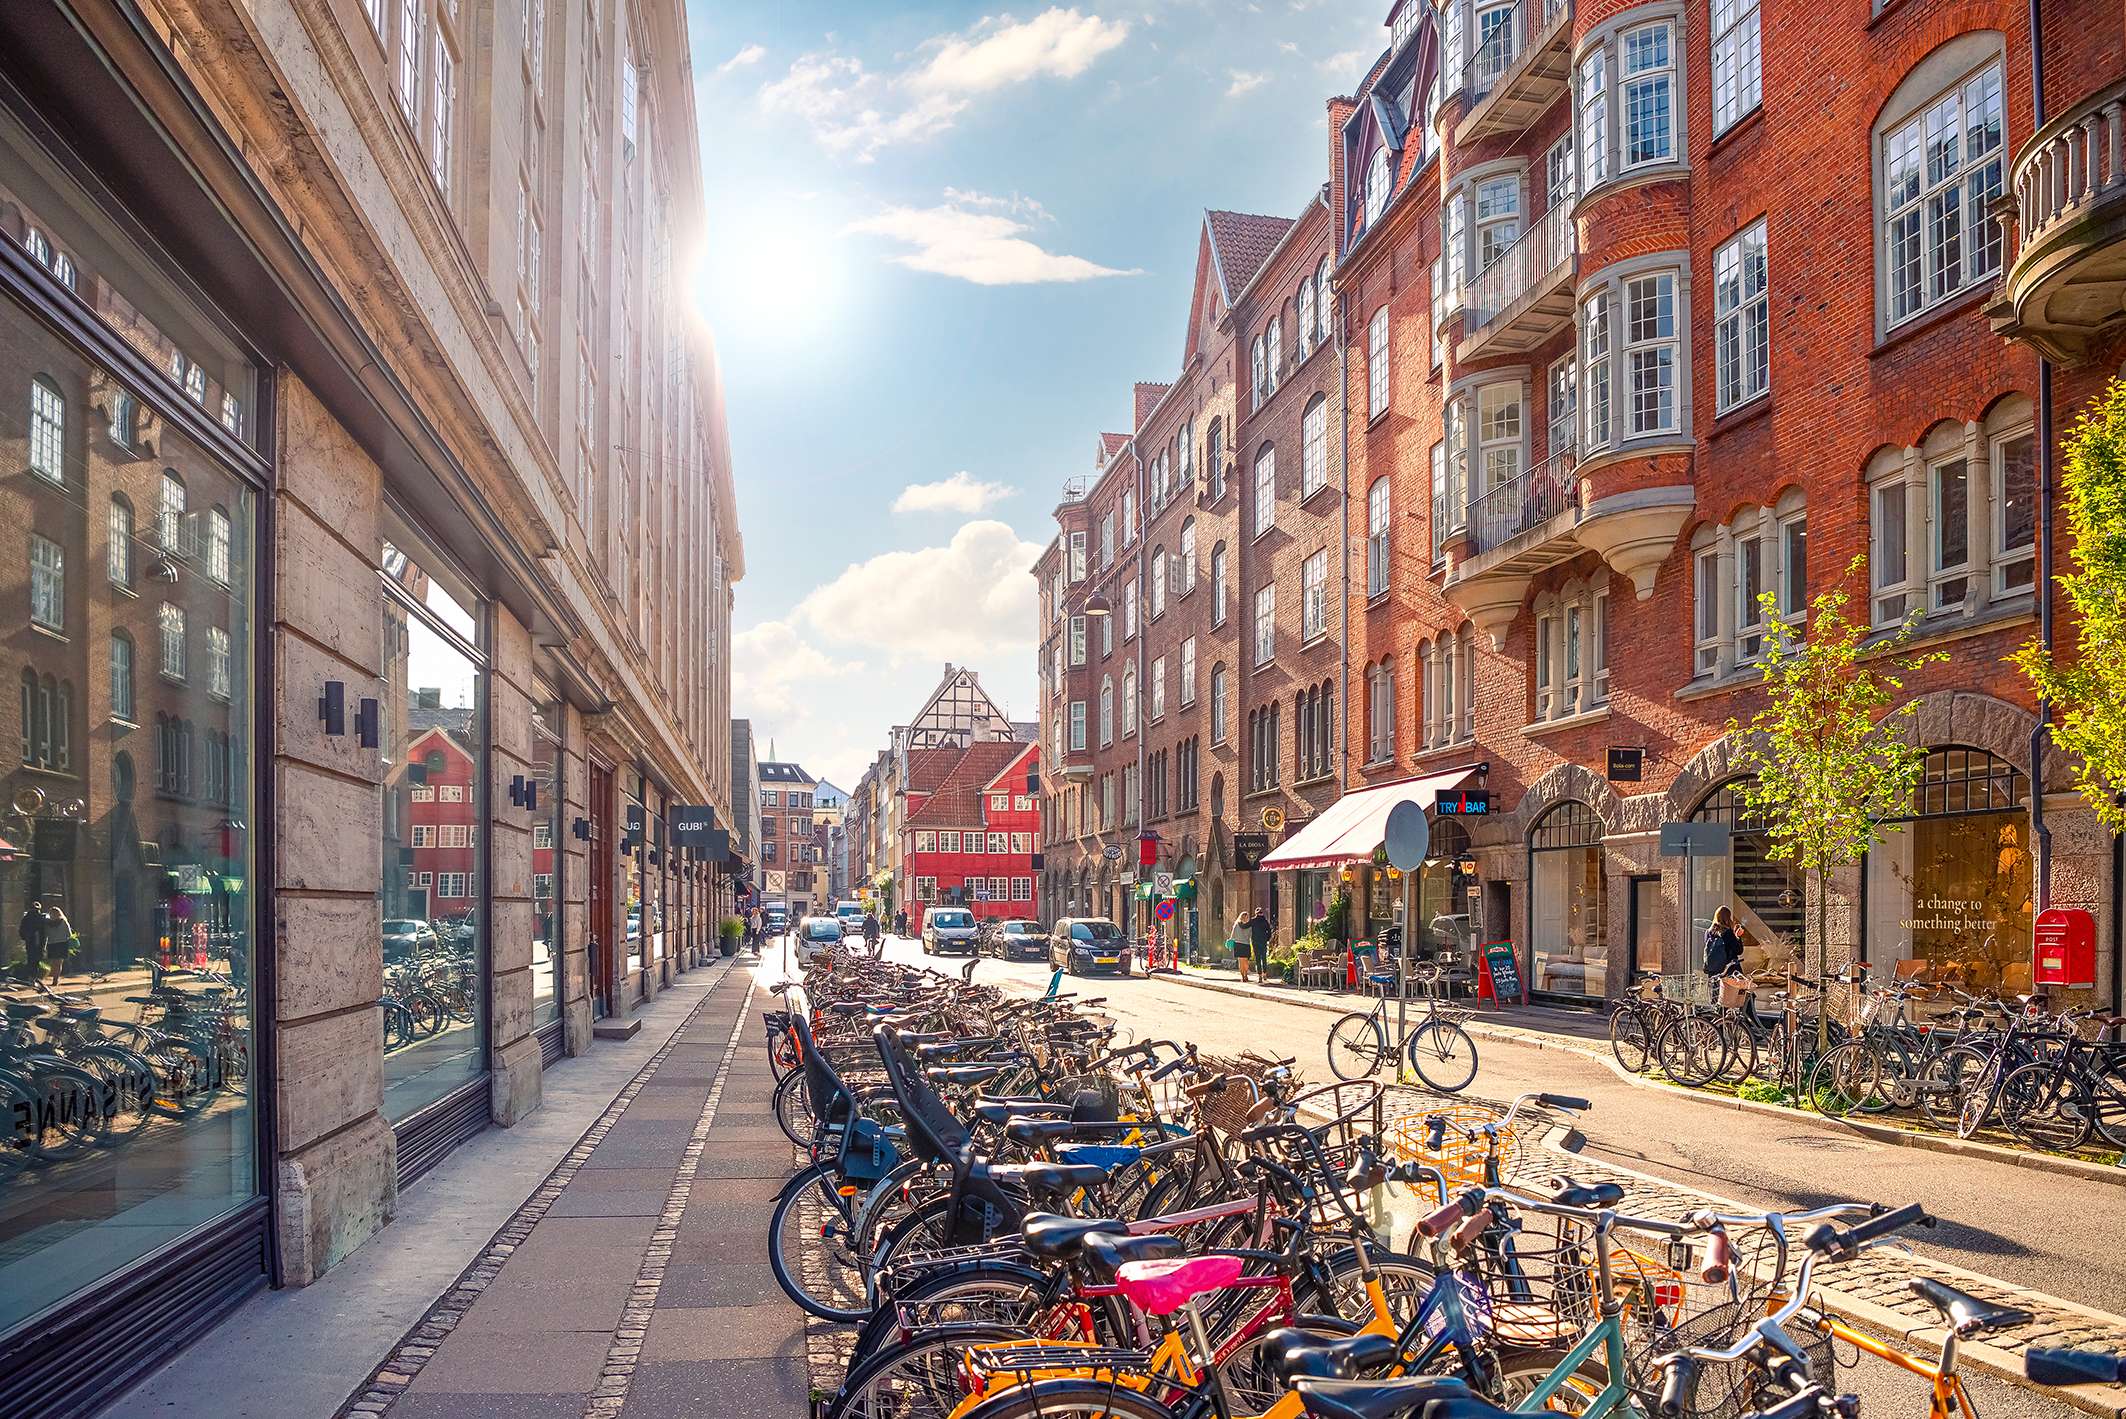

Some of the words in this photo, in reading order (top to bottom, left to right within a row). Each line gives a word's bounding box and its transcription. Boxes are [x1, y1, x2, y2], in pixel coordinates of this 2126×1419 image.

[1439, 801, 1458, 813] TRY
[1465, 801, 1486, 813] BAR
[678, 822, 703, 831] GUBI
[1917, 899, 1924, 909] a
[1927, 893, 1968, 915] change
[1970, 899, 1982, 910] to
[1899, 913, 1962, 935] something
[1964, 914, 1998, 930] better
